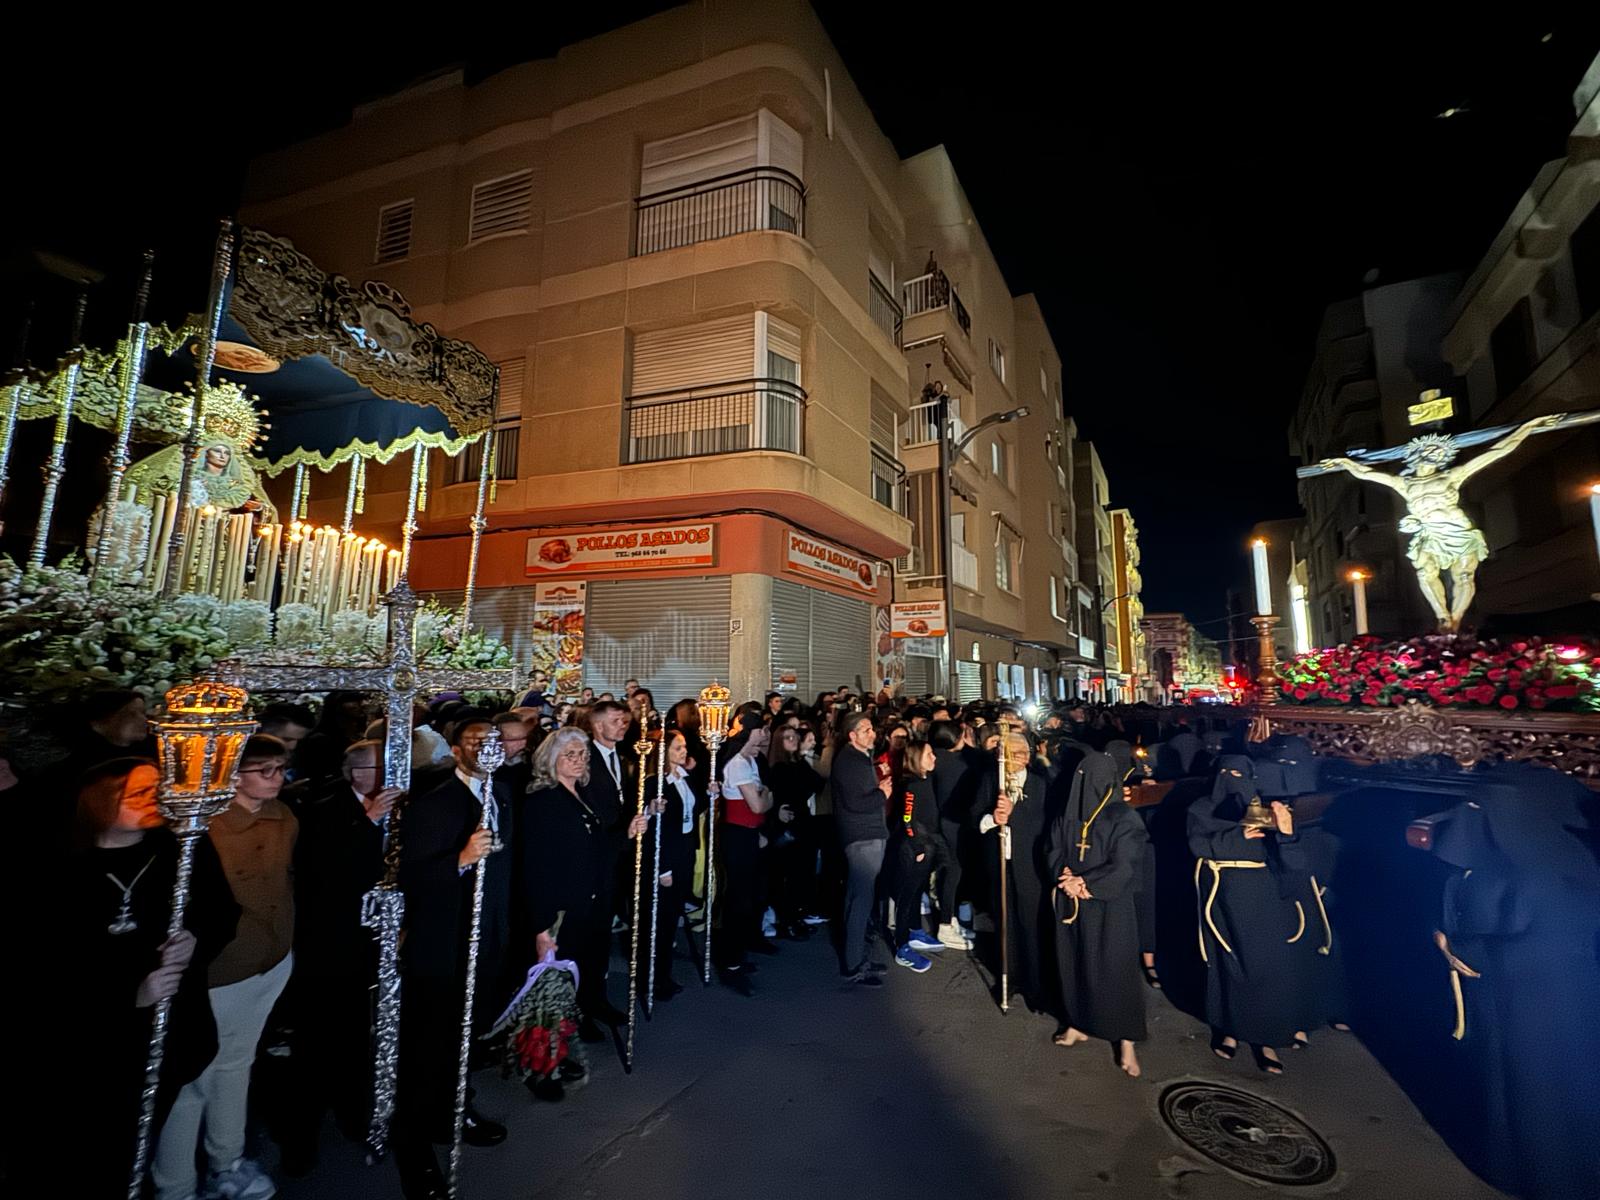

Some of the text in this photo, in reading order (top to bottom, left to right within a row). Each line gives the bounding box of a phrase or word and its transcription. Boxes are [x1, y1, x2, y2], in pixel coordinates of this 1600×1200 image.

[576, 527, 710, 551] POLLOS ASADOS
[791, 536, 827, 561] POLLOS
[827, 550, 858, 573] ASADOS
[904, 791, 914, 816] JUST
